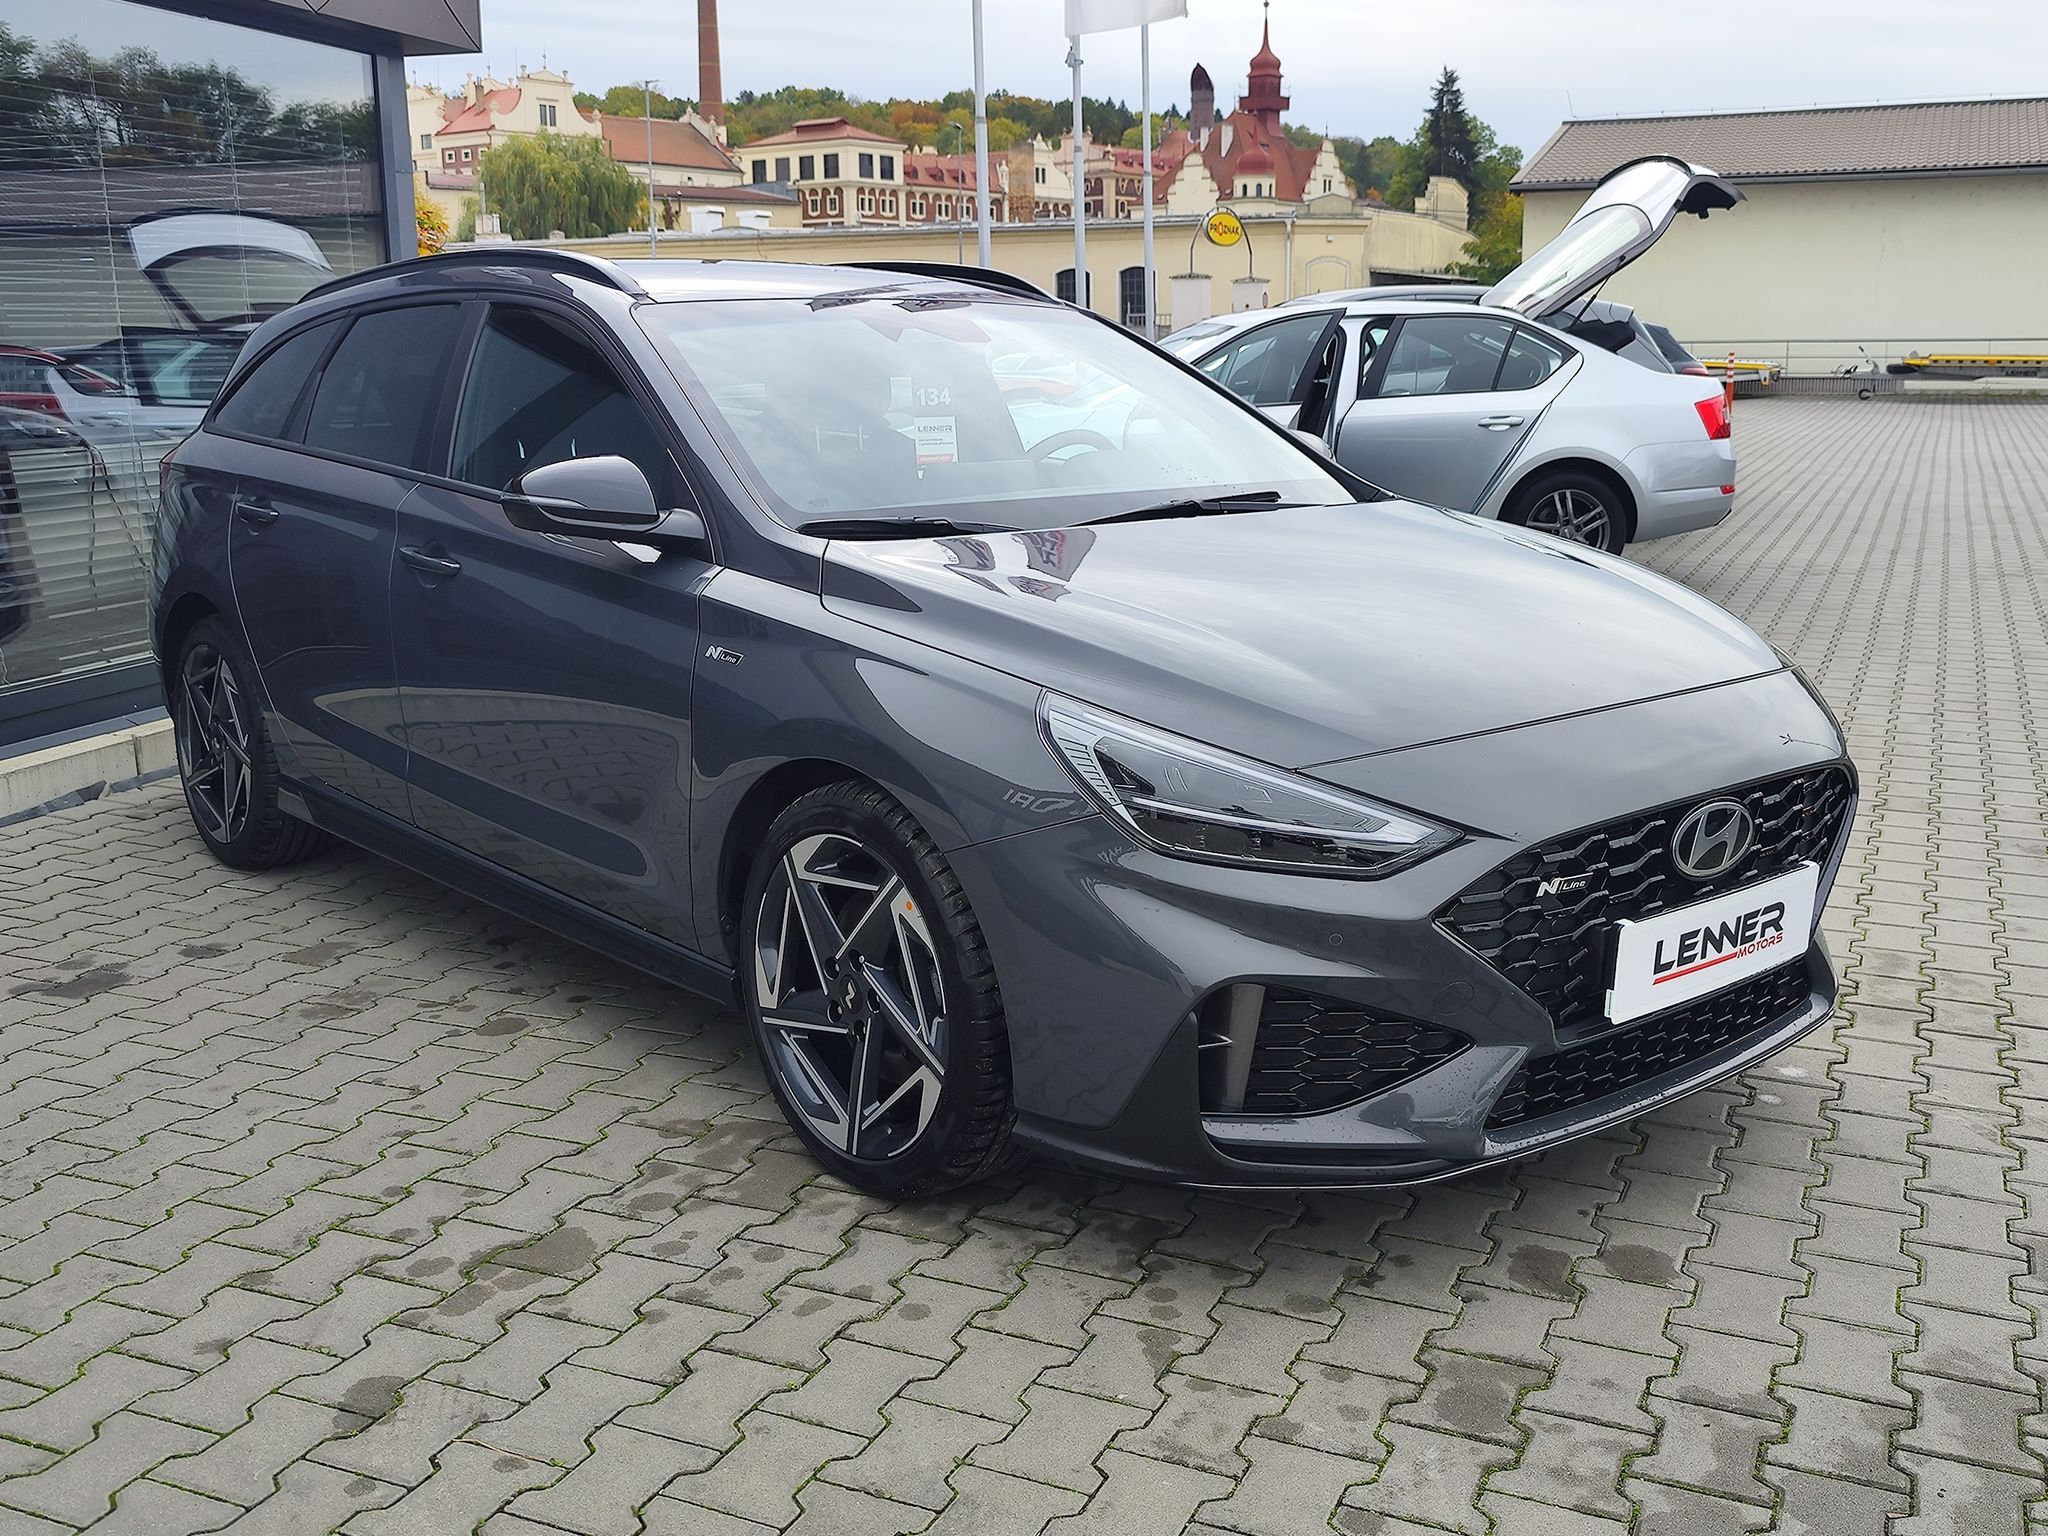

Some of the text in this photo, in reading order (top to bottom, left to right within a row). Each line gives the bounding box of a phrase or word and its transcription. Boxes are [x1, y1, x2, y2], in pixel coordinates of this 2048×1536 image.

[916, 387, 952, 407] 134
[917, 425, 953, 433] LENNER
[1562, 880, 1587, 890] Line
[1653, 901, 1786, 976] LENNER
[1737, 932, 1784, 959] MOTORS
